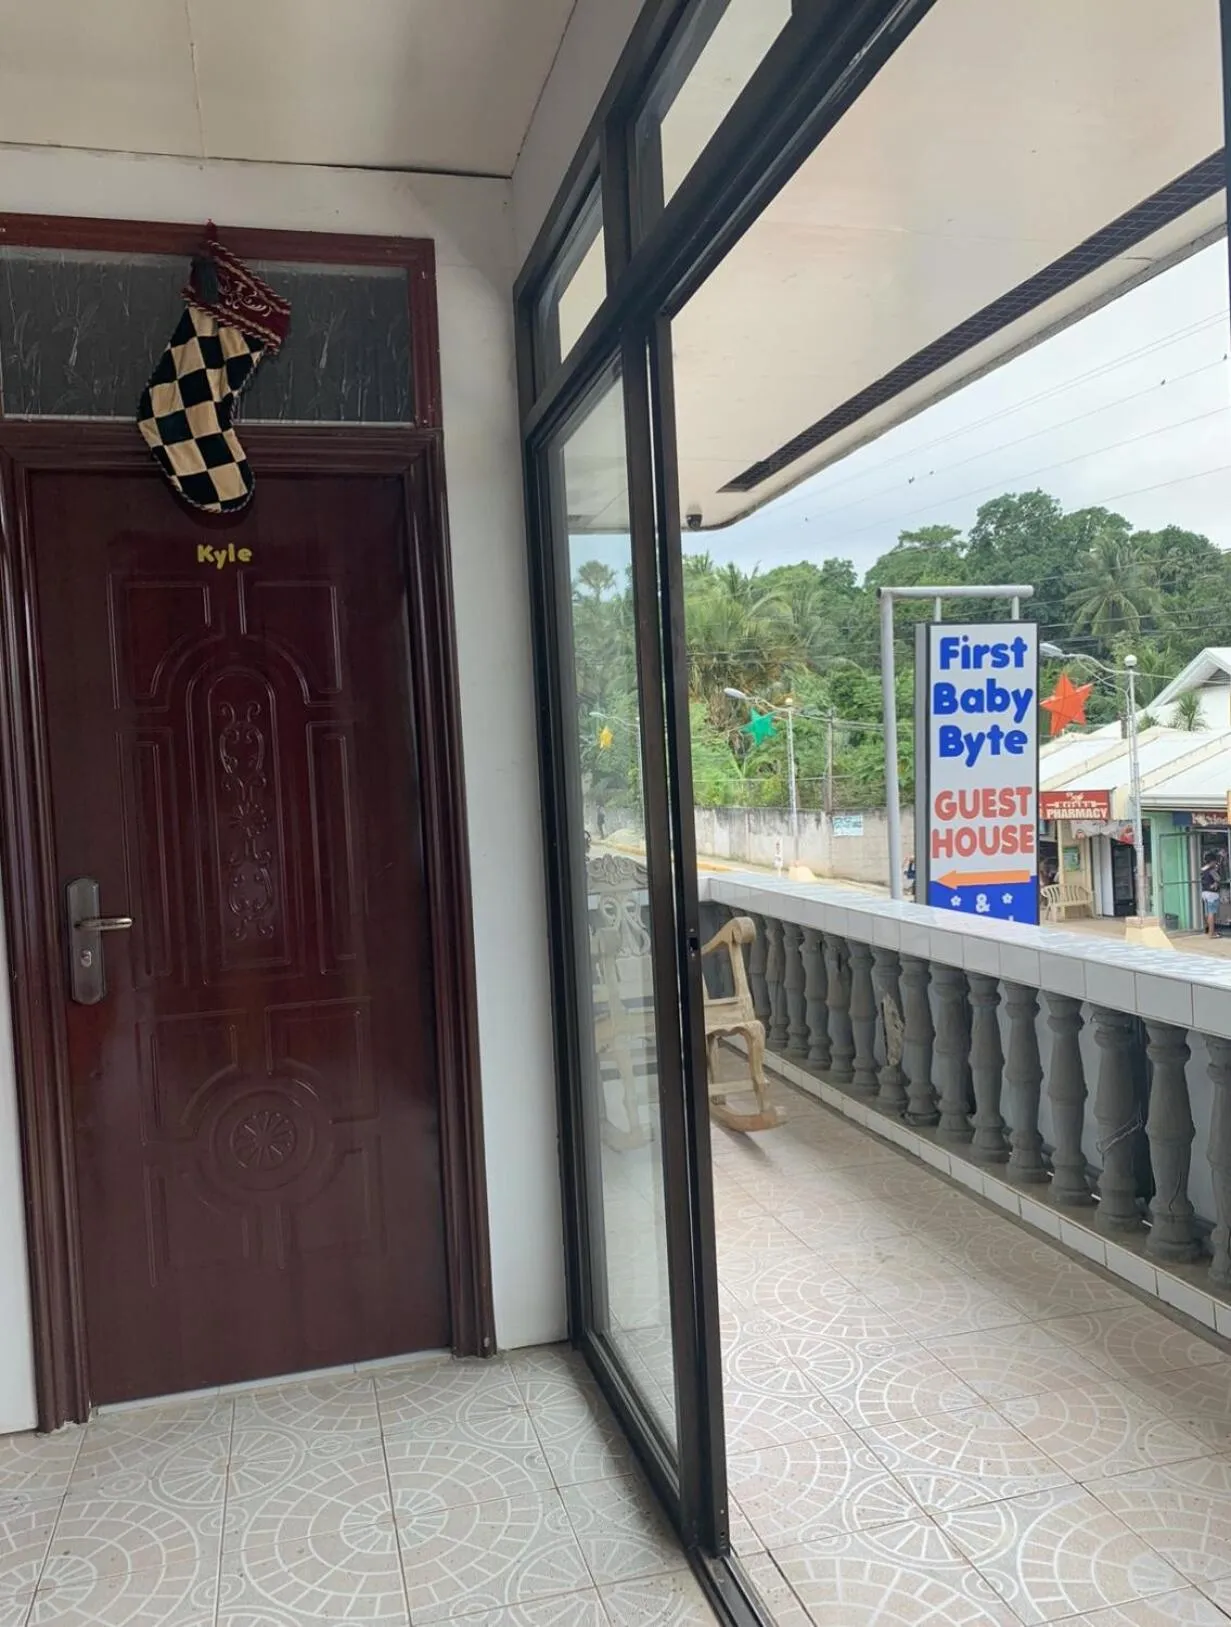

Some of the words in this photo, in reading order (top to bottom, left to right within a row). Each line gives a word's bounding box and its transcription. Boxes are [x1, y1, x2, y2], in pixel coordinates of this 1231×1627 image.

[197, 543, 252, 569] Kyle
[939, 635, 1028, 670] First
[933, 678, 1033, 724] Baby
[939, 724, 1028, 767] Byte
[934, 786, 1033, 821] GUEST
[1046, 807, 1108, 819] PHARMACY
[931, 823, 1034, 859] HOUSE
[976, 893, 991, 913] &
